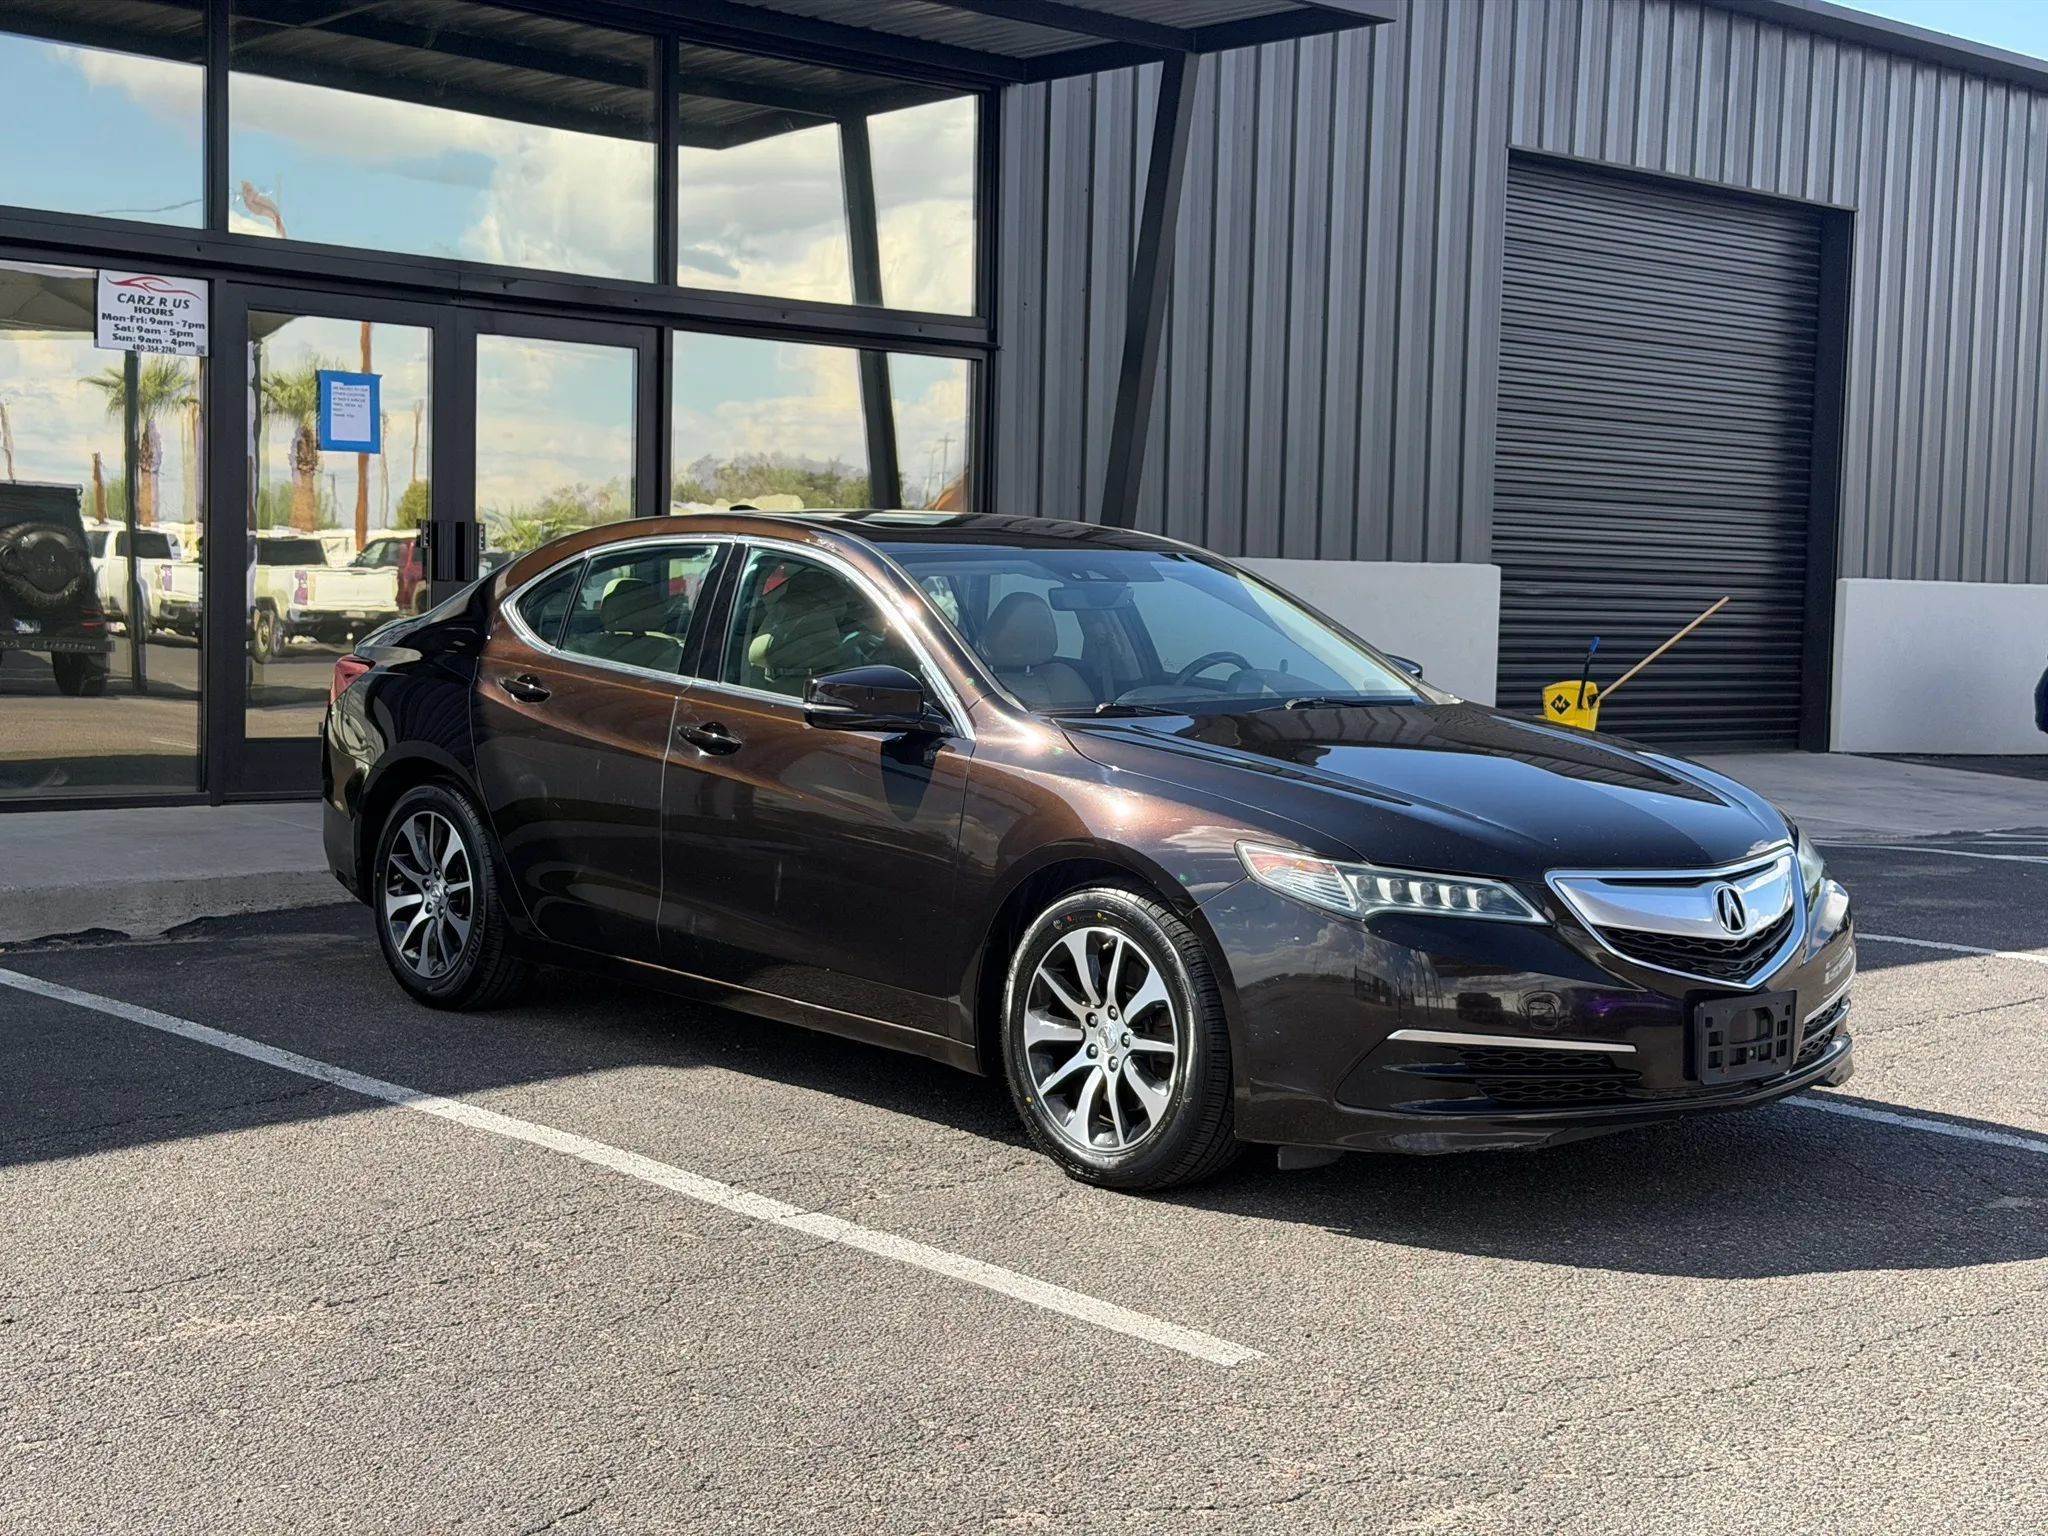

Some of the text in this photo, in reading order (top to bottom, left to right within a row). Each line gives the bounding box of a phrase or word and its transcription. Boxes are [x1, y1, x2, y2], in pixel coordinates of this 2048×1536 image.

[117, 293, 191, 310] CARZ R US
[134, 306, 174, 316] HOURS
[101, 312, 148, 324] Mon-Fri:
[149, 318, 174, 327] 9am
[181, 320, 206, 331] 7pm
[113, 324, 135, 333] Sat:
[136, 325, 162, 335] 9am
[169, 329, 194, 339] 5pm
[112, 333, 136, 343] Sun:
[138, 335, 163, 345] 9am
[171, 338, 196, 348] 4pm
